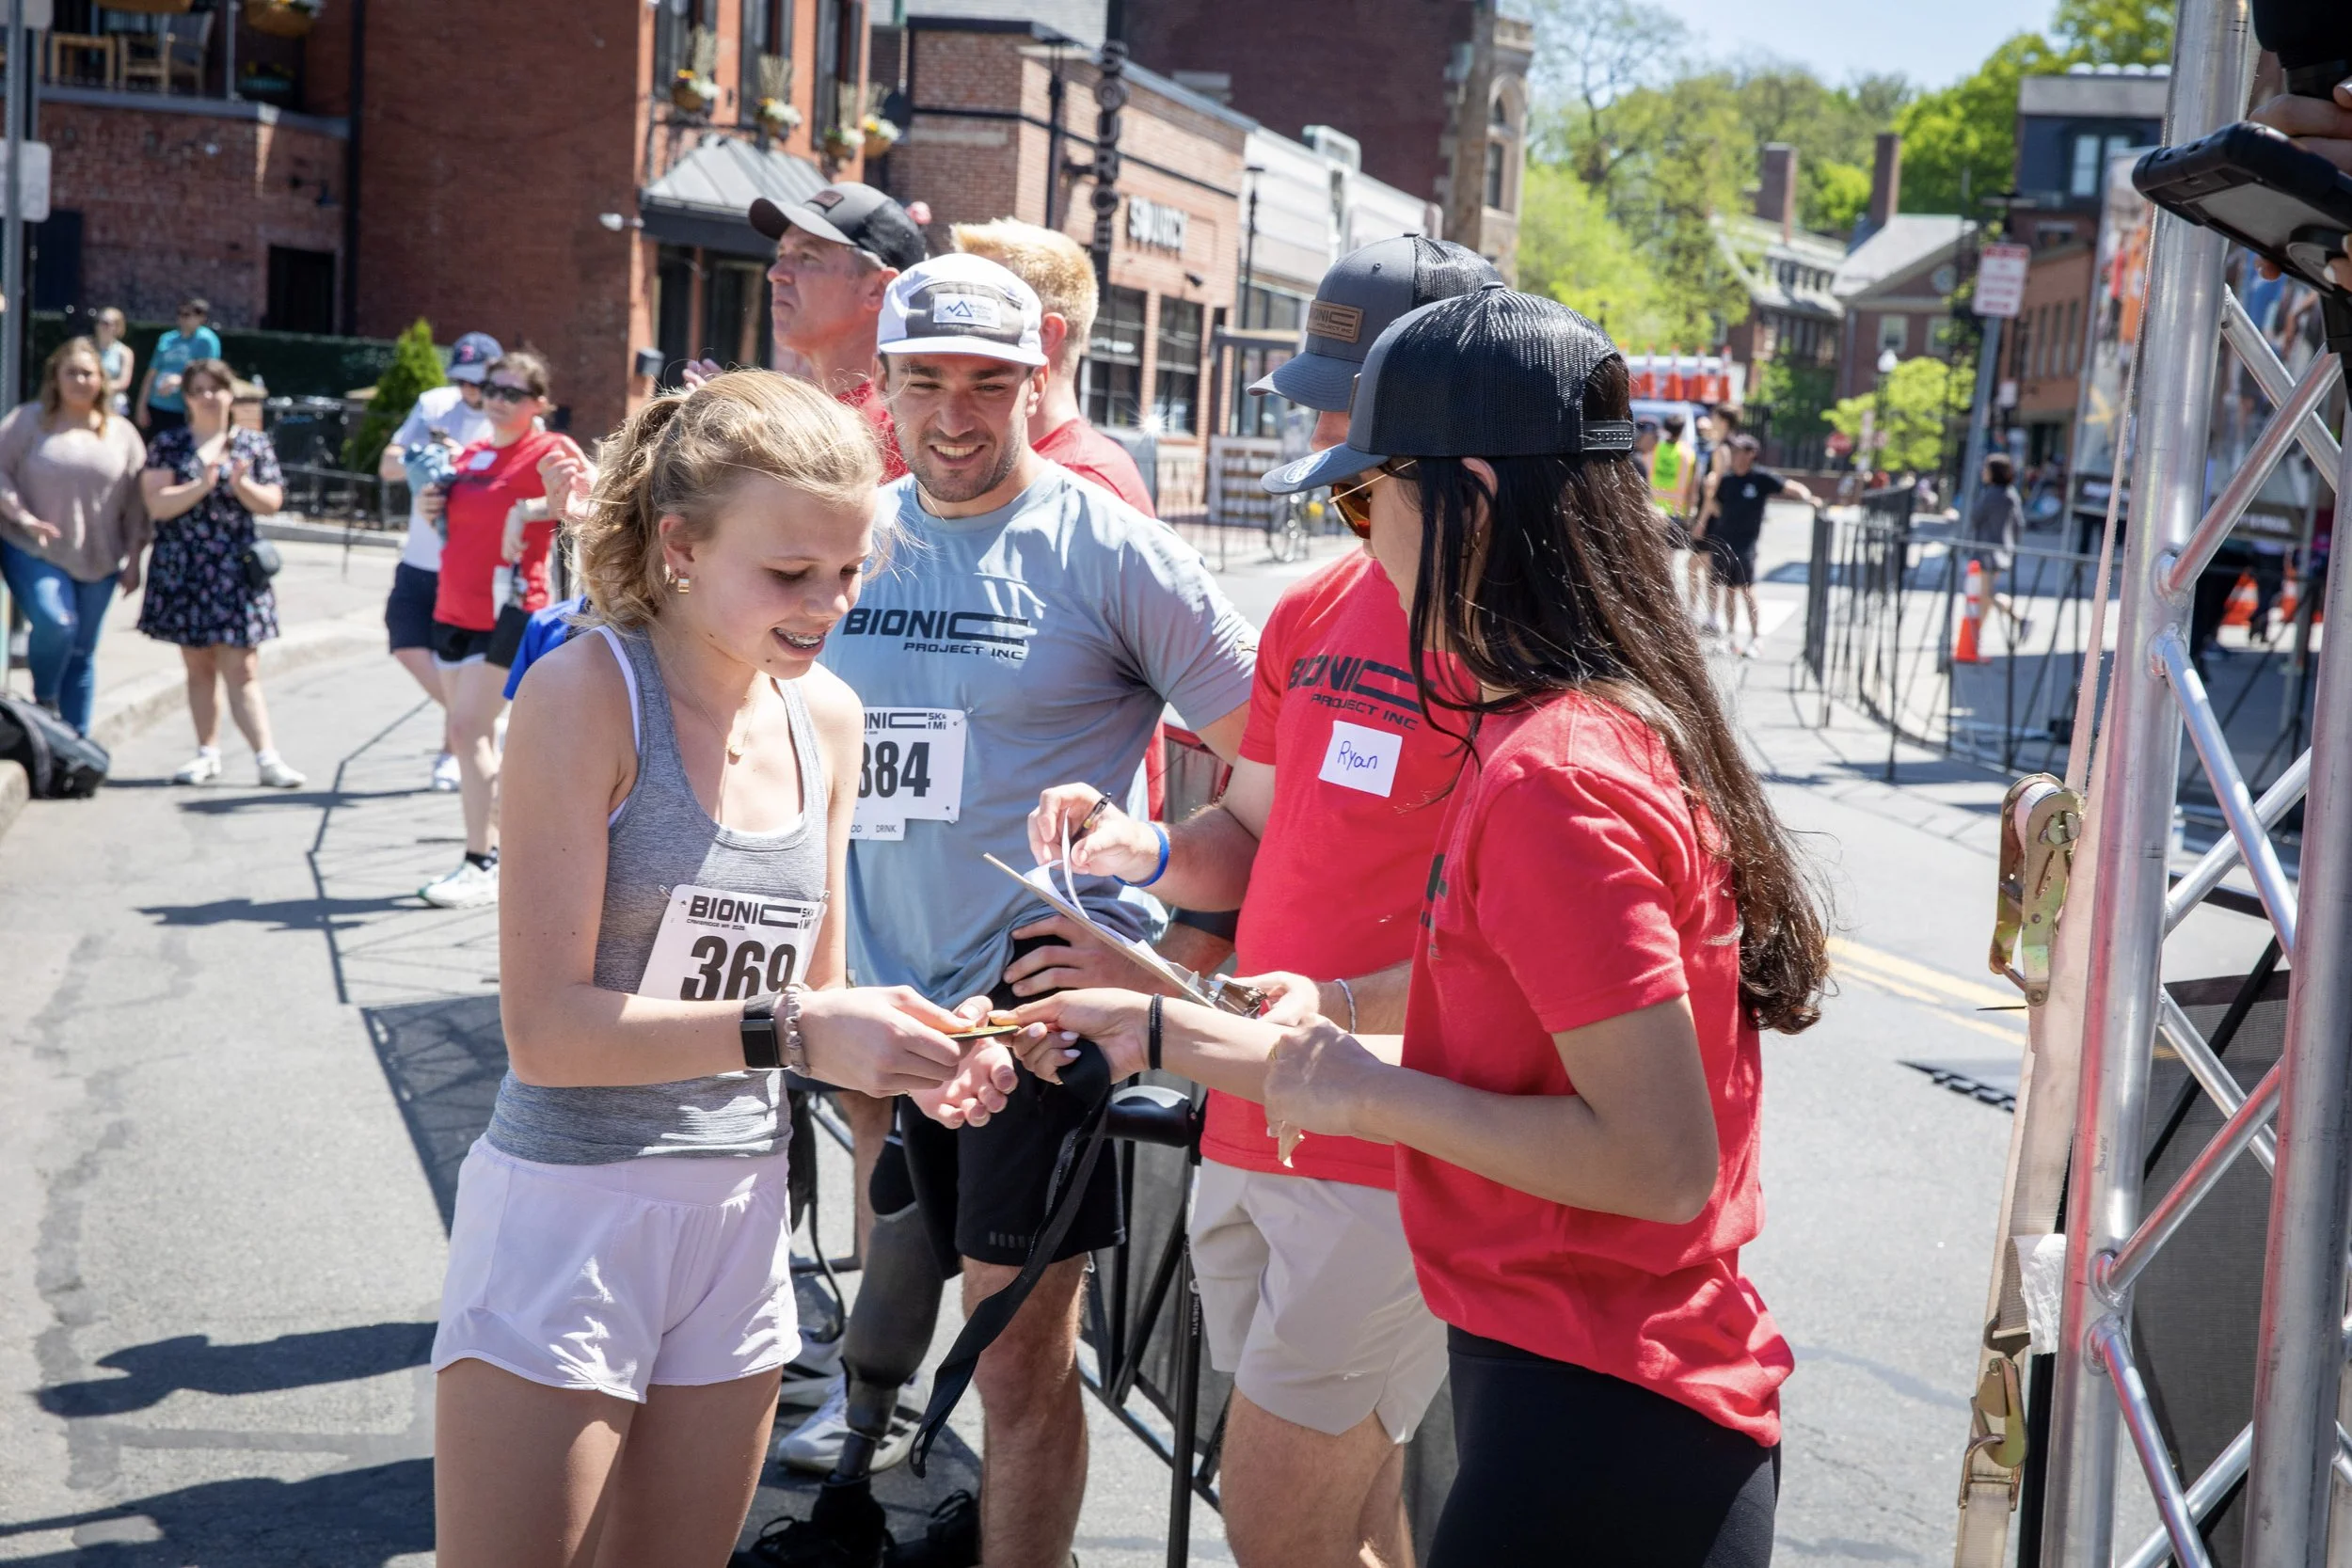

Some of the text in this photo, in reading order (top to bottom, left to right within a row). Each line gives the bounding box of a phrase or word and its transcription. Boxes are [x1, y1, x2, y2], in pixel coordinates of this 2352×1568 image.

[1090, 40, 1128, 252] SOURCE
[843, 609, 1028, 646] BIONIC
[903, 642, 1024, 660] PROJECT INC
[1288, 654, 1437, 716] BONIC
[865, 712, 928, 729] NIC
[1311, 693, 1420, 731] PROJECT INC
[1337, 740, 1378, 771] Ryan
[689, 895, 802, 928] BIONIC
